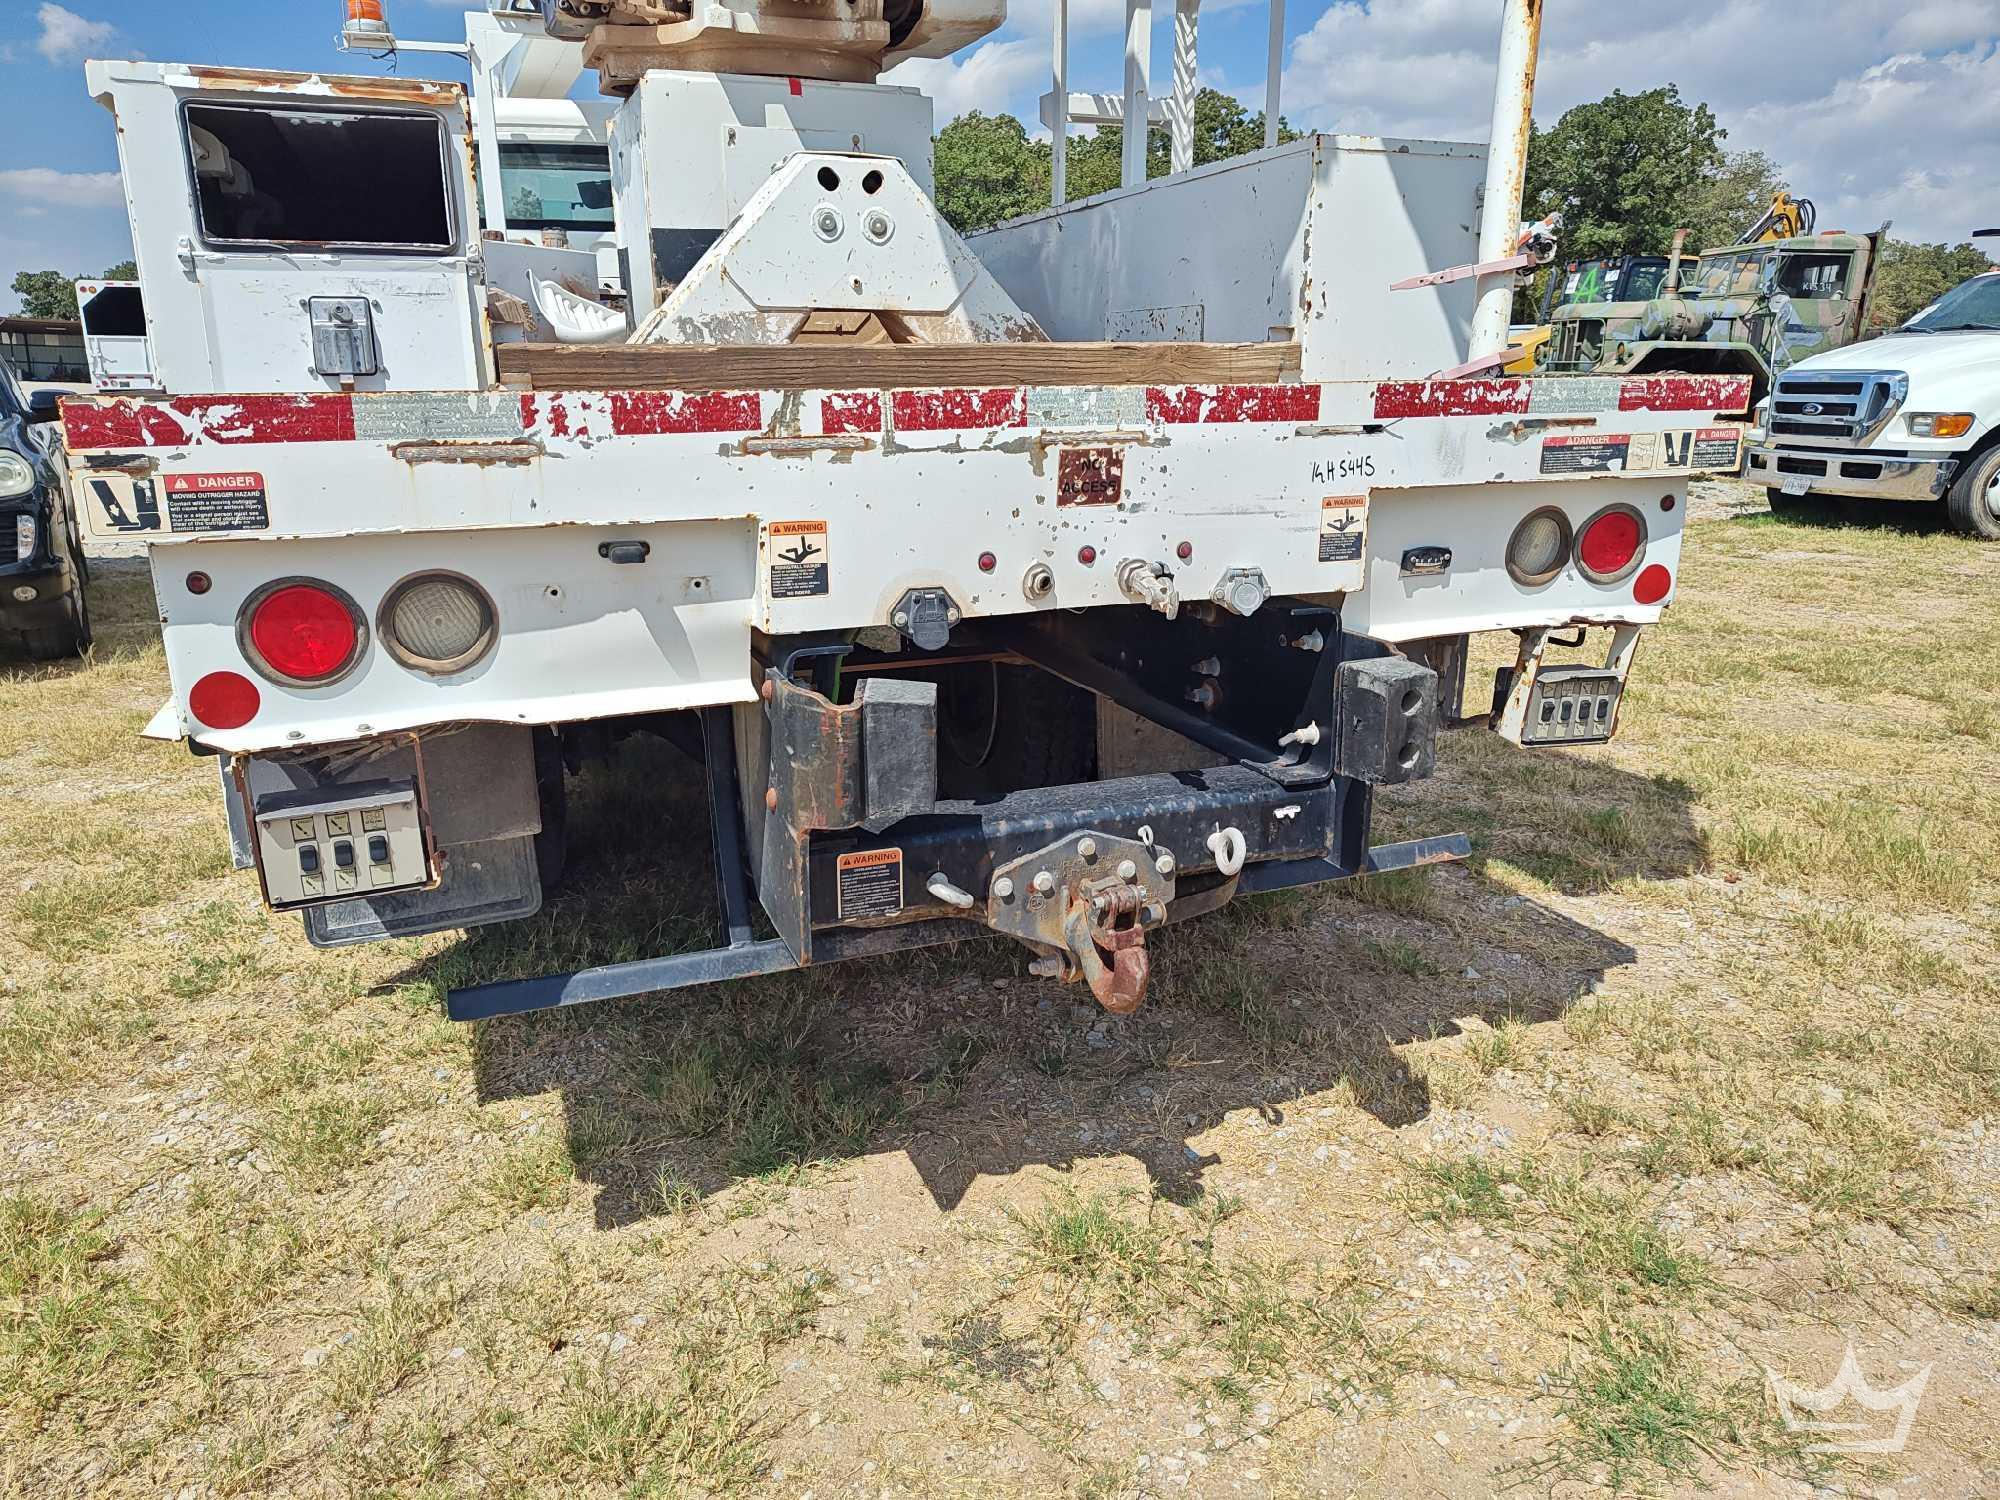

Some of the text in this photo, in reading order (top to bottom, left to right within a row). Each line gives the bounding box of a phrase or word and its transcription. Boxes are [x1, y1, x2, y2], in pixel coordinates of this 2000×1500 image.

[1575, 436, 1609, 444] DANGER
[198, 476, 255, 487] DANGER
[1062, 480, 1117, 495] ACCESS
[1334, 497, 1363, 506] WARNING
[783, 523, 823, 533] WARNING
[853, 852, 897, 864] WARNING
